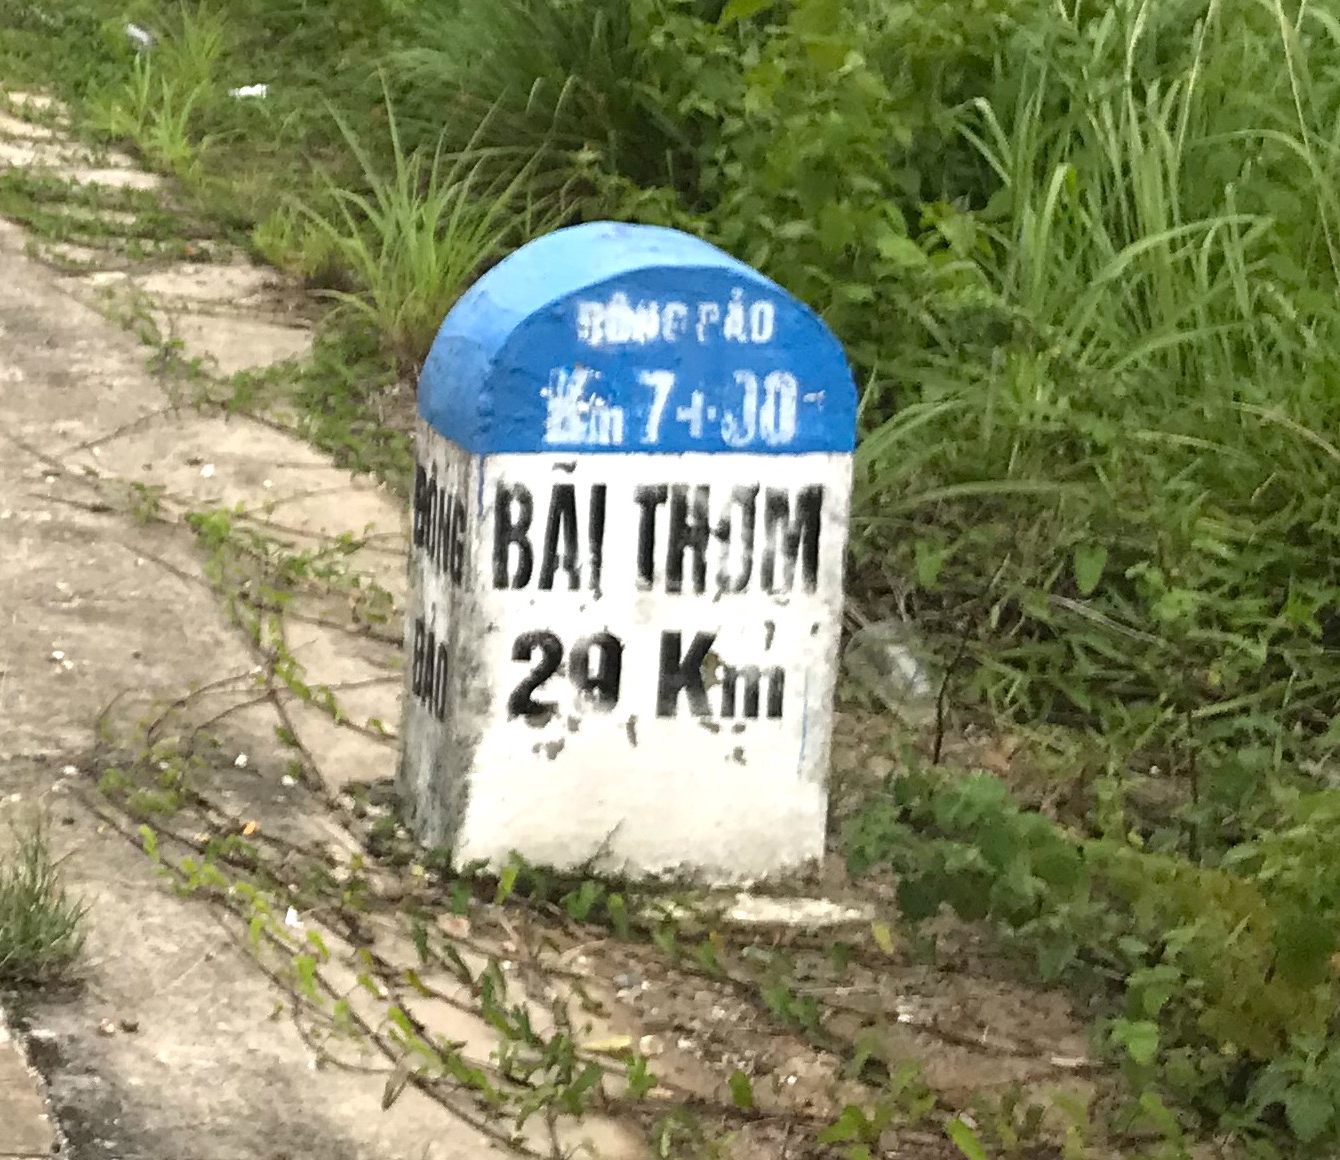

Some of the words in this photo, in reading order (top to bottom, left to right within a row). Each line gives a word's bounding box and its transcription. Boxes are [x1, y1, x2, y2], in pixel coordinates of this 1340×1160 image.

[492, 459, 609, 593] BÃI
[633, 482, 825, 596] THƠM
[507, 629, 625, 722] 29
[656, 629, 786, 721] Km
